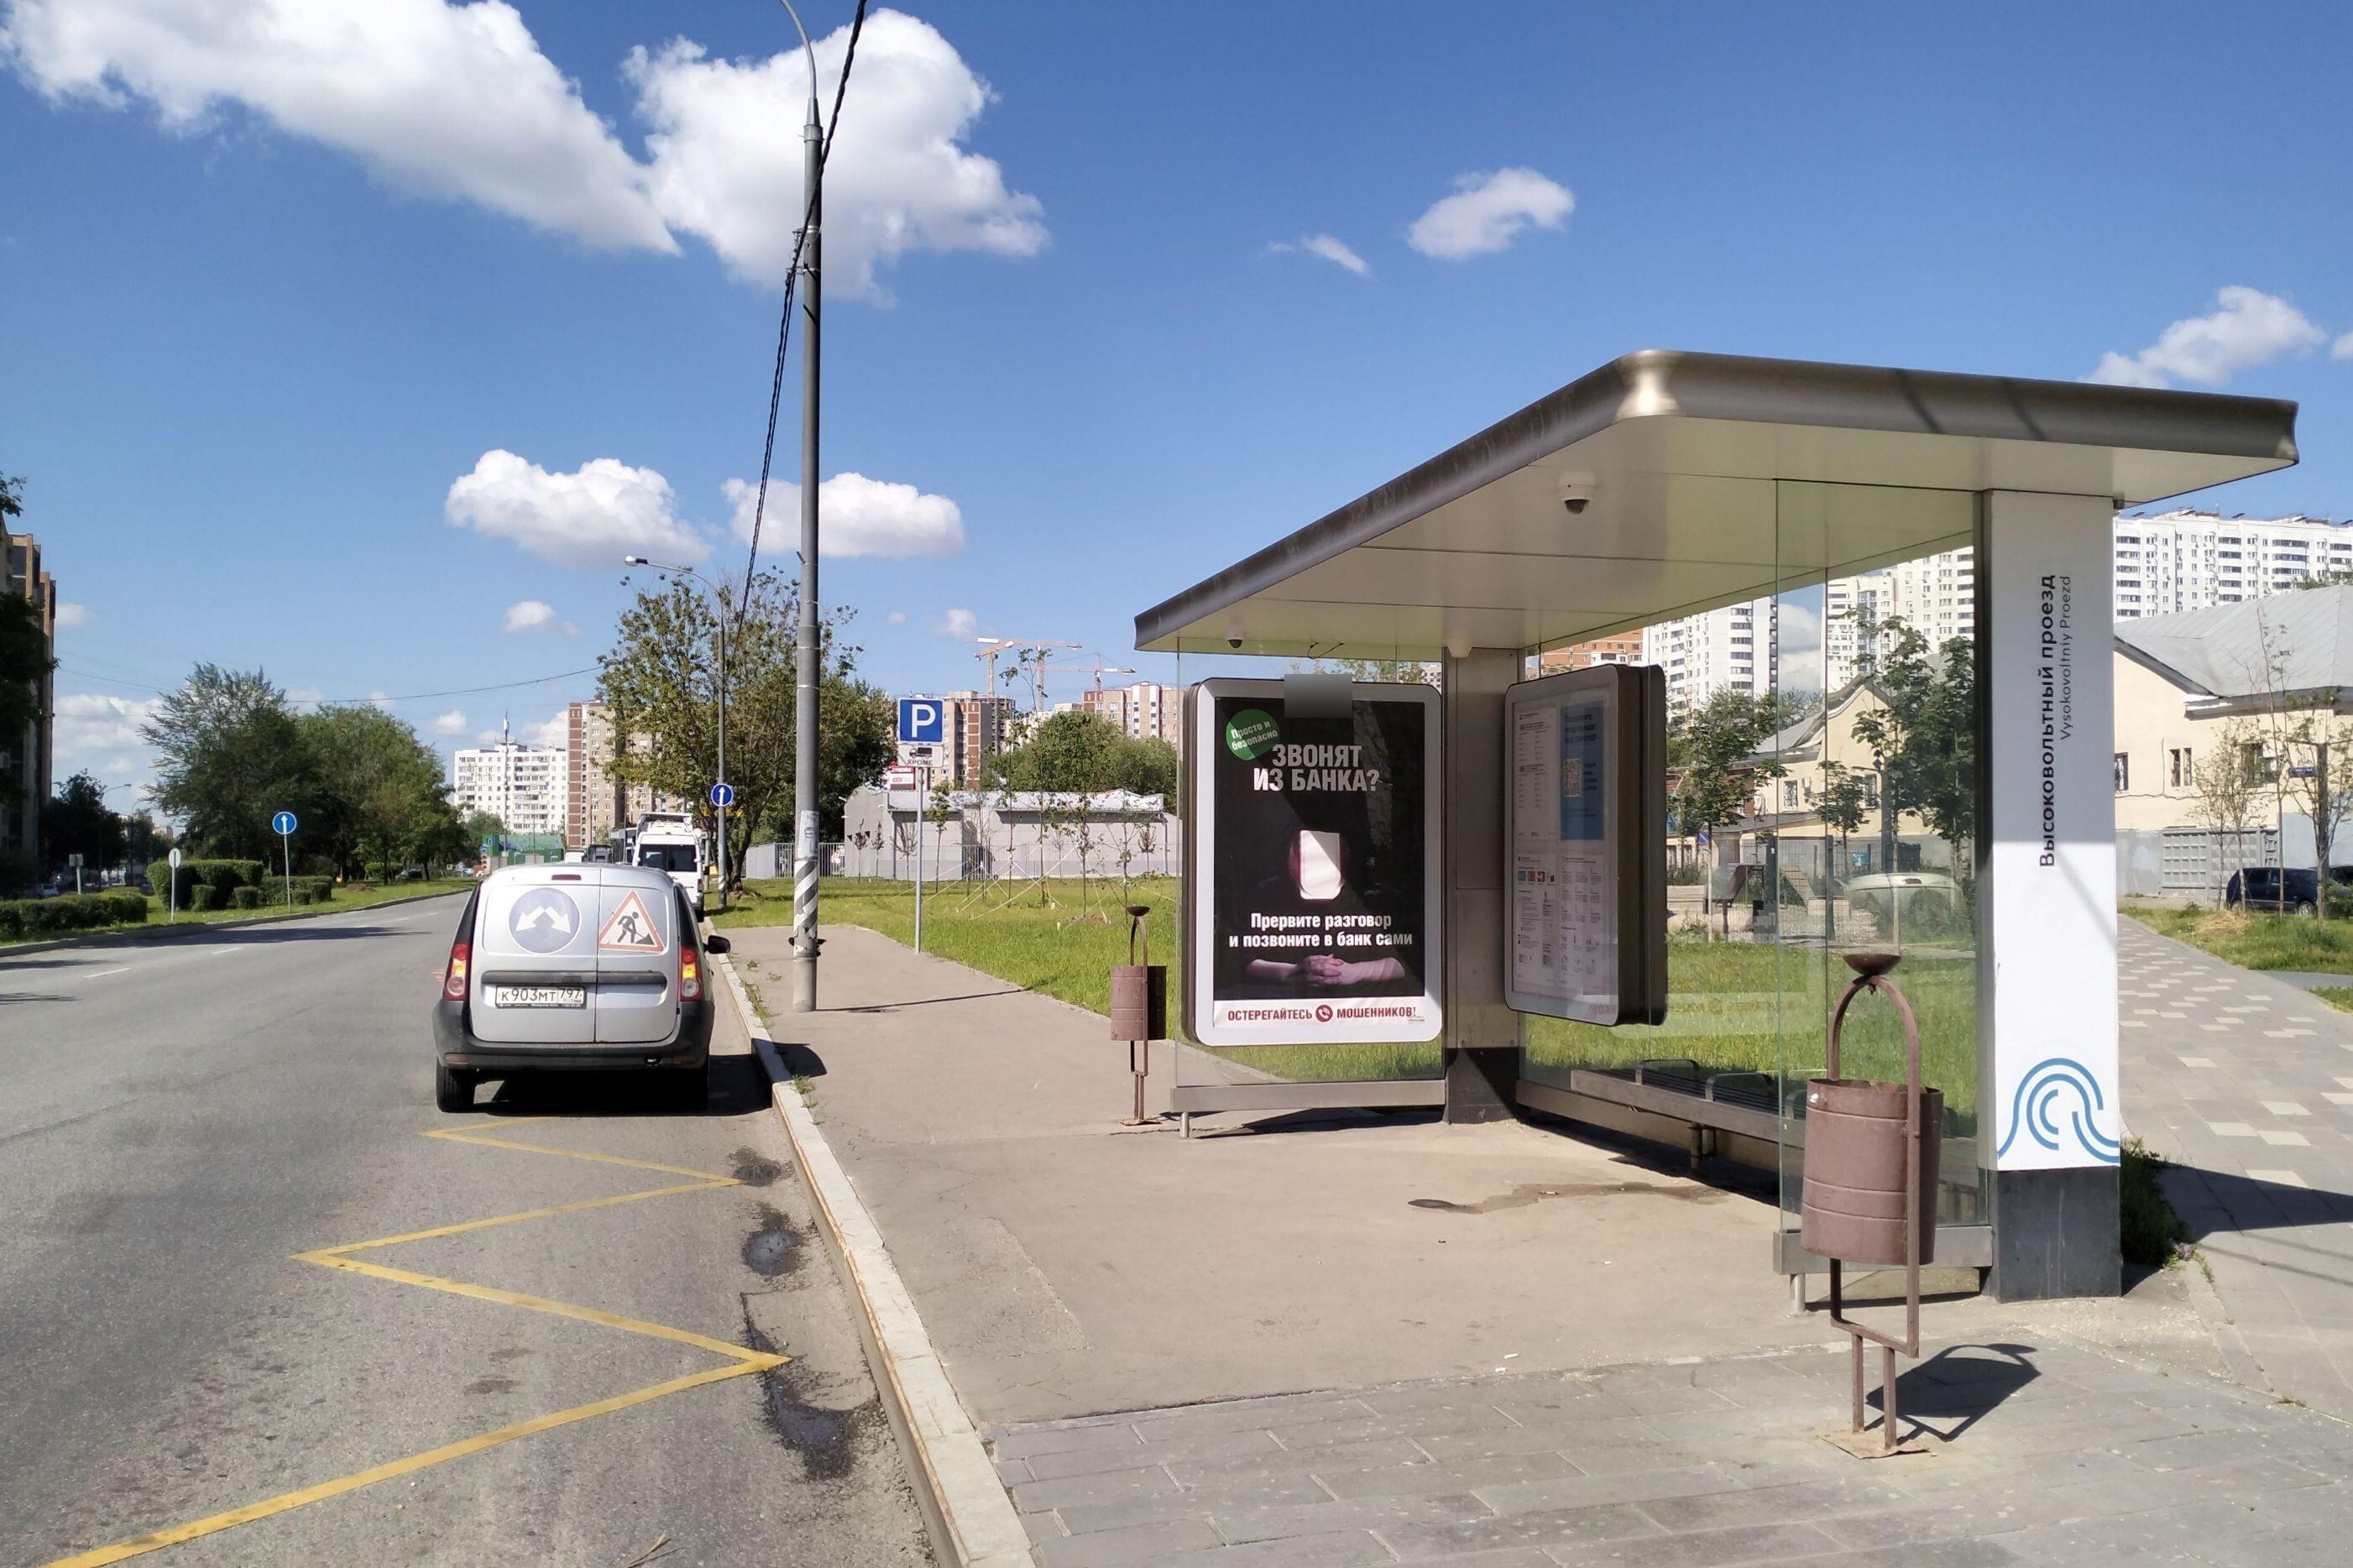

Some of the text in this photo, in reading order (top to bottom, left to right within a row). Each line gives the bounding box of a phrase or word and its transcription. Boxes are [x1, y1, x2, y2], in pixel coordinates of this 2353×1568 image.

[2059, 576, 2073, 740] Vysokovoltniy Proezd
[912, 703, 936, 738] P
[1231, 724, 1263, 739] Просто
[2038, 575, 2057, 867] Высоковольтный проезд
[1231, 729, 1278, 751] безопасно
[1272, 744, 1362, 767] ЗВОНЯТ
[1253, 768, 1380, 792] ИЗ БАНКА?
[1251, 912, 1392, 932] Прервите разговор
[1229, 931, 1413, 948] и позвоните в банк сами
[501, 988, 581, 1001] К903МТ 797
[1227, 1006, 1416, 1022] ОСТЕРЕГАЙТЕСЬ МОШЕННИКОВ!
